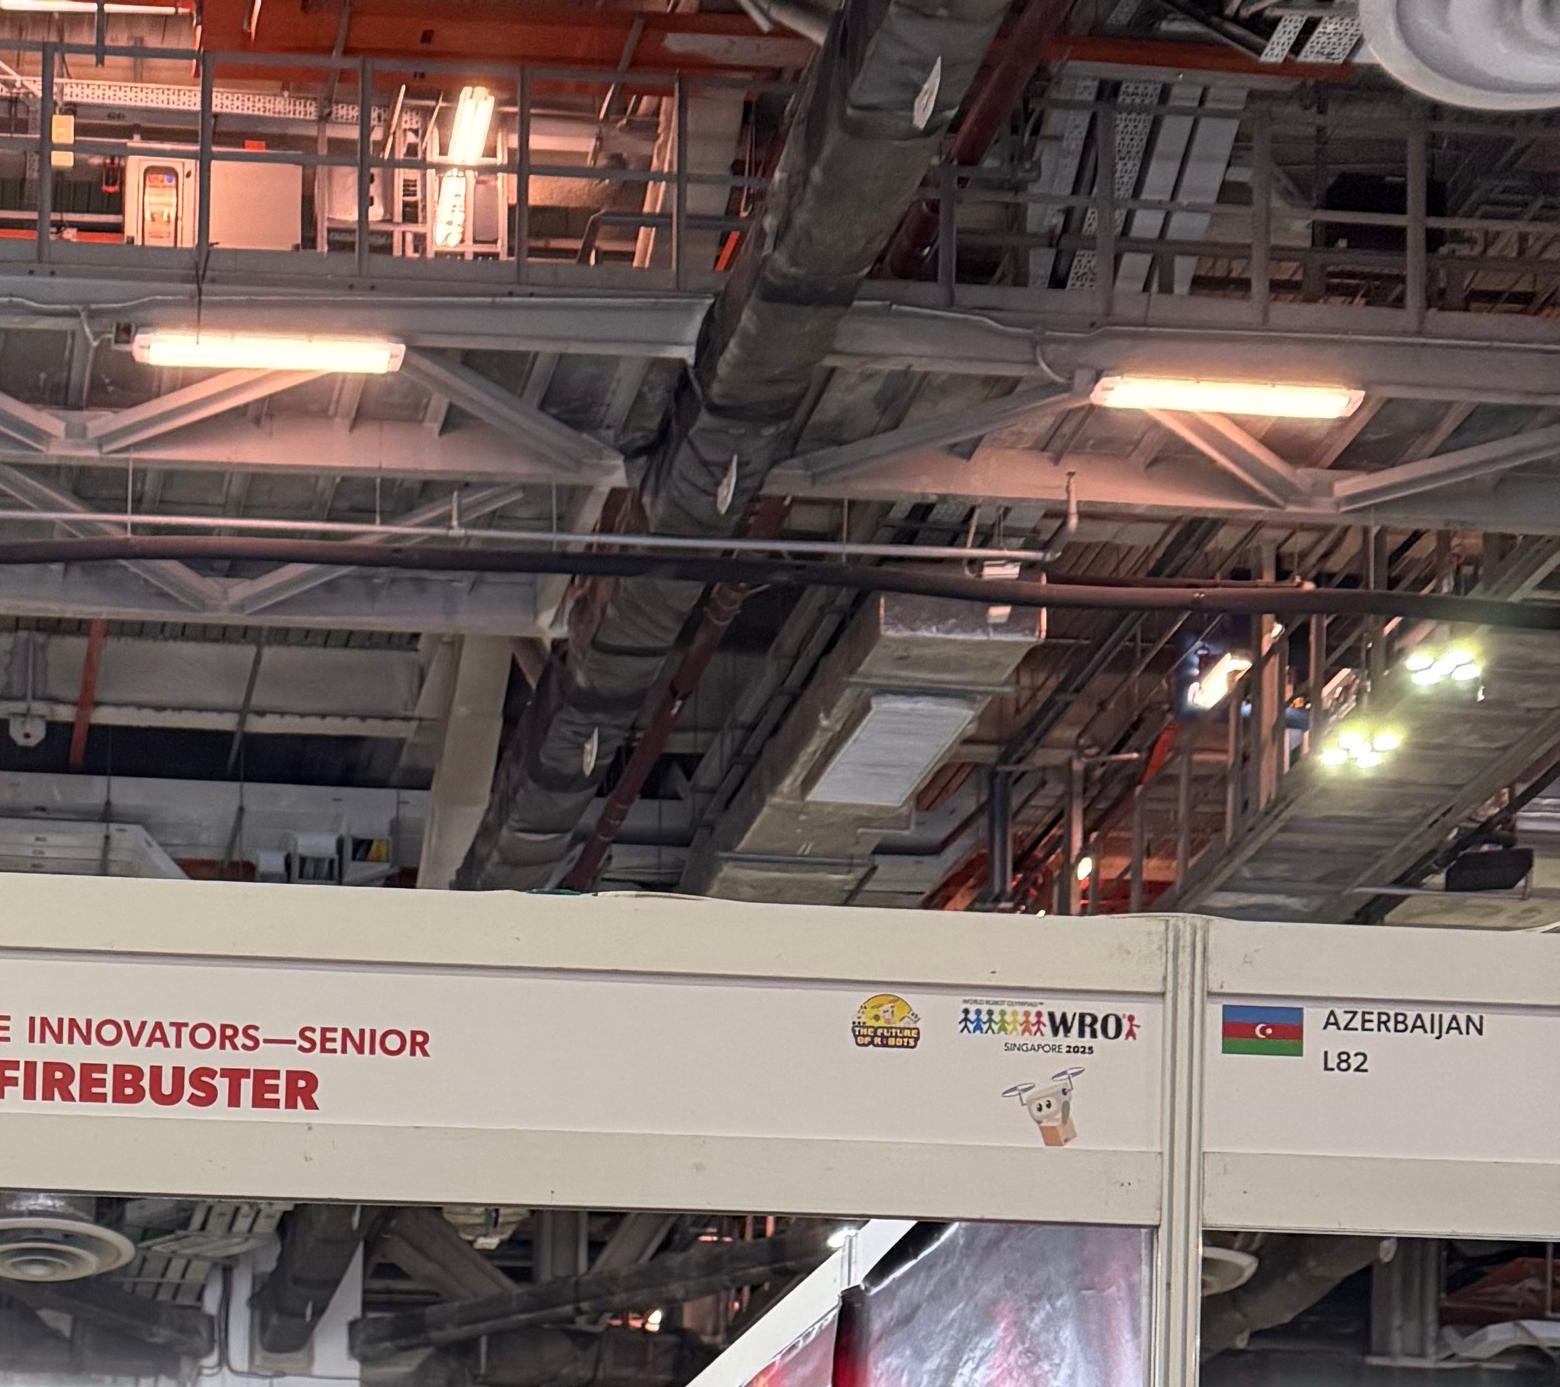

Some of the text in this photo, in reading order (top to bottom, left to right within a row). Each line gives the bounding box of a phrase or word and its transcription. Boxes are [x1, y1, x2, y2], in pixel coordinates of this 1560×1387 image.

[1047, 1011, 1123, 1040] WRO
[1323, 1009, 1484, 1039] AZERBAIJAN
[1004, 1042, 1094, 1055] SINGAPORE 2025
[1323, 1051, 1369, 1073] L82
